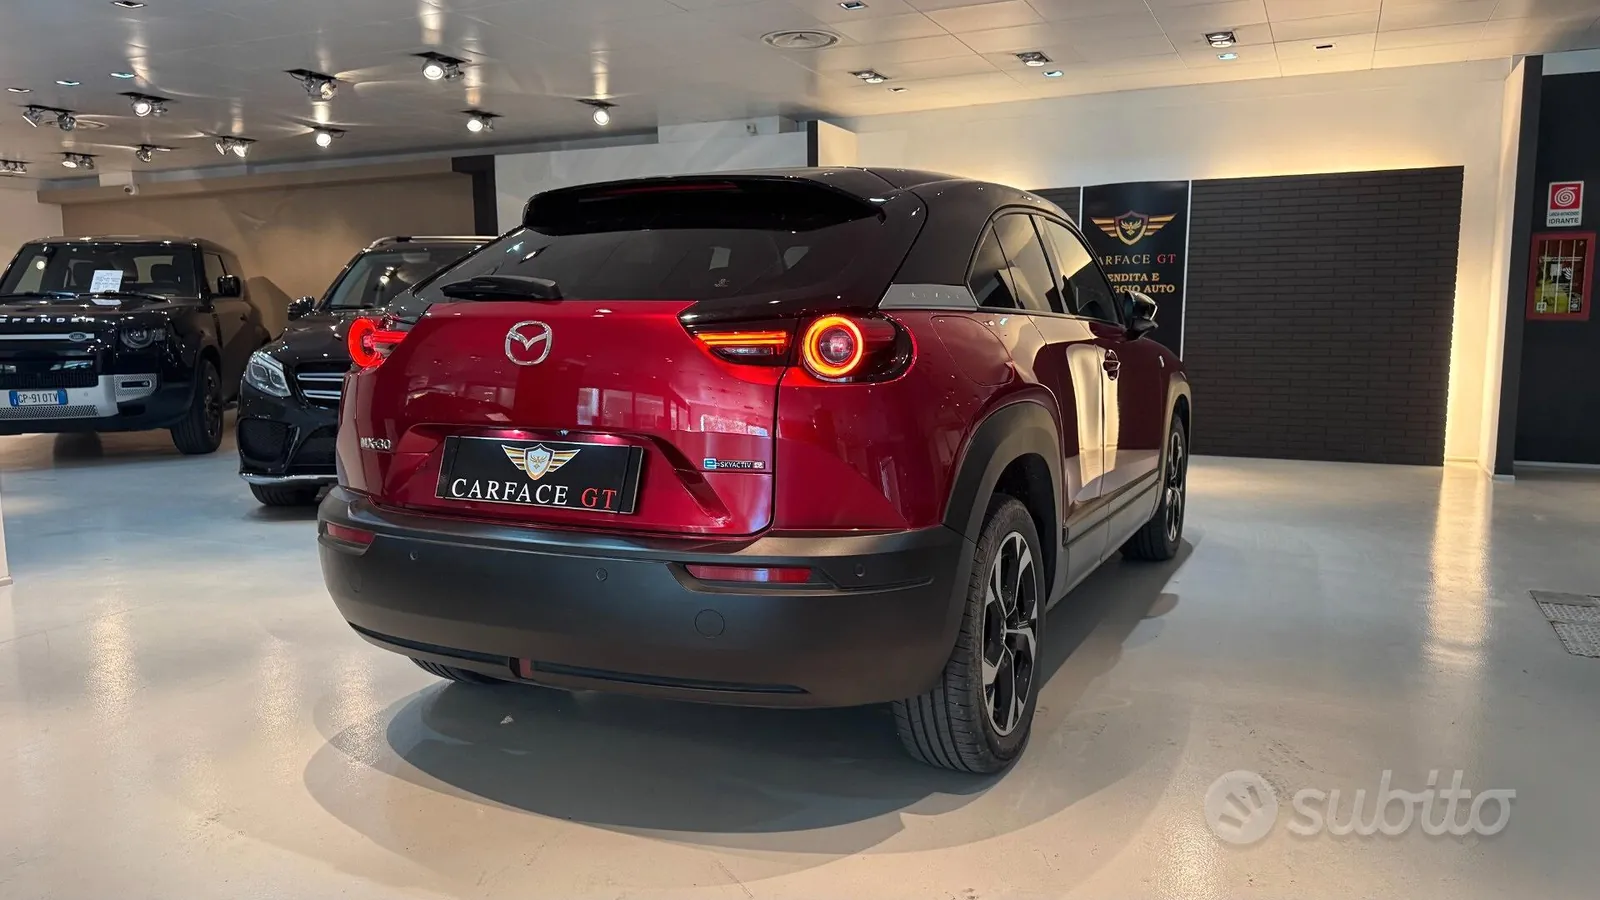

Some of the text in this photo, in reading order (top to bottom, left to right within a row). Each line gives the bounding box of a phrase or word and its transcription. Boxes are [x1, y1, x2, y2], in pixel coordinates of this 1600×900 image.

[1098, 254, 1176, 265] ARFACE GT
[1107, 273, 1160, 282] ENDITA E
[1144, 284, 1175, 293] AUTO
[360, 437, 391, 449] MX-30
[451, 478, 617, 510] CARFACE GT
